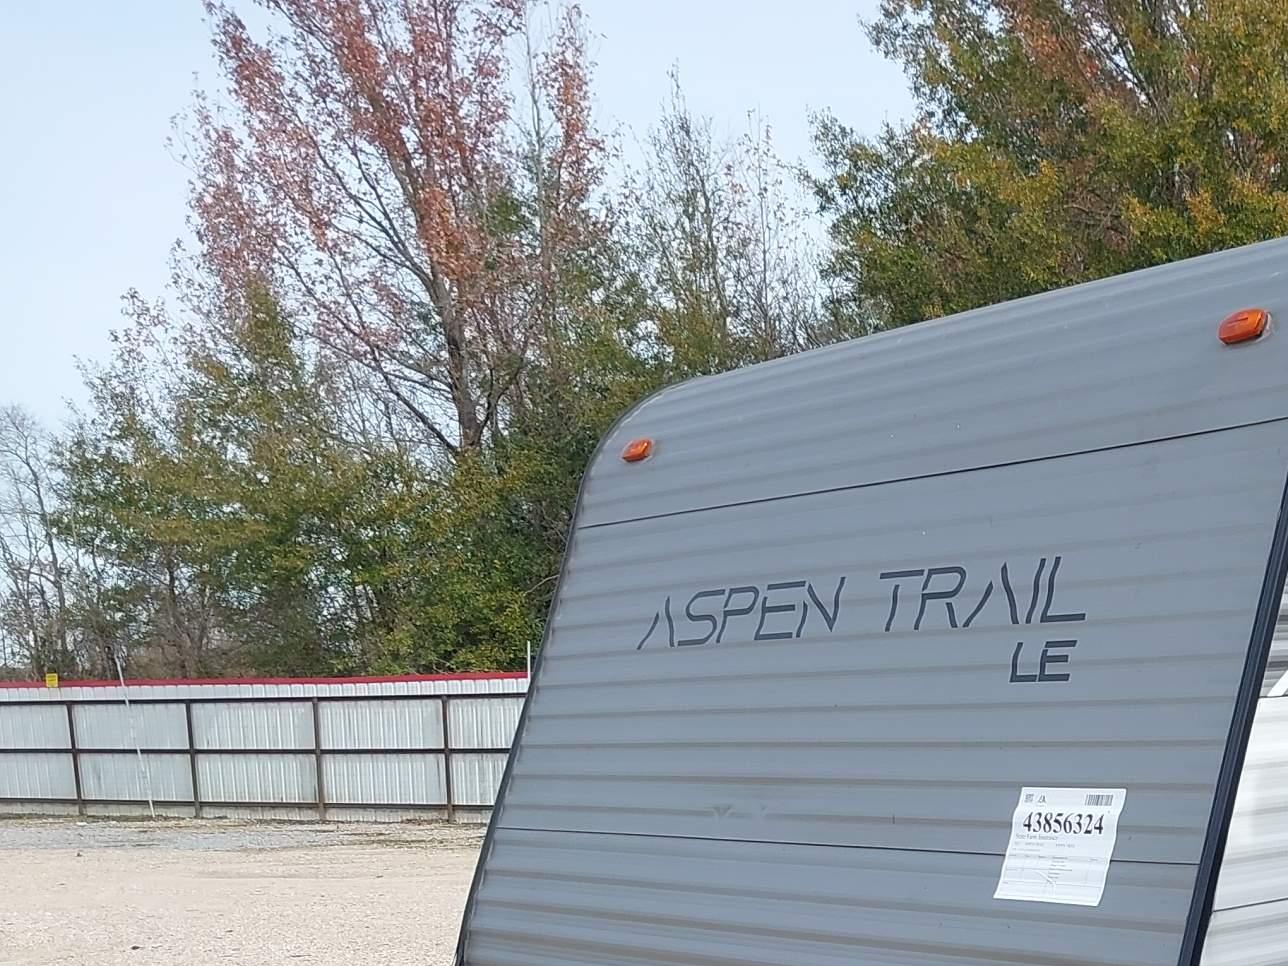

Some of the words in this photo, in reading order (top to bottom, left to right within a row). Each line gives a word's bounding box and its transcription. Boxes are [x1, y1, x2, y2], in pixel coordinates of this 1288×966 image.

[637, 576, 846, 650] ASPEN
[879, 556, 1086, 632] TRAIL
[1009, 639, 1077, 683] LE
[1023, 811, 1105, 835] 43856324
